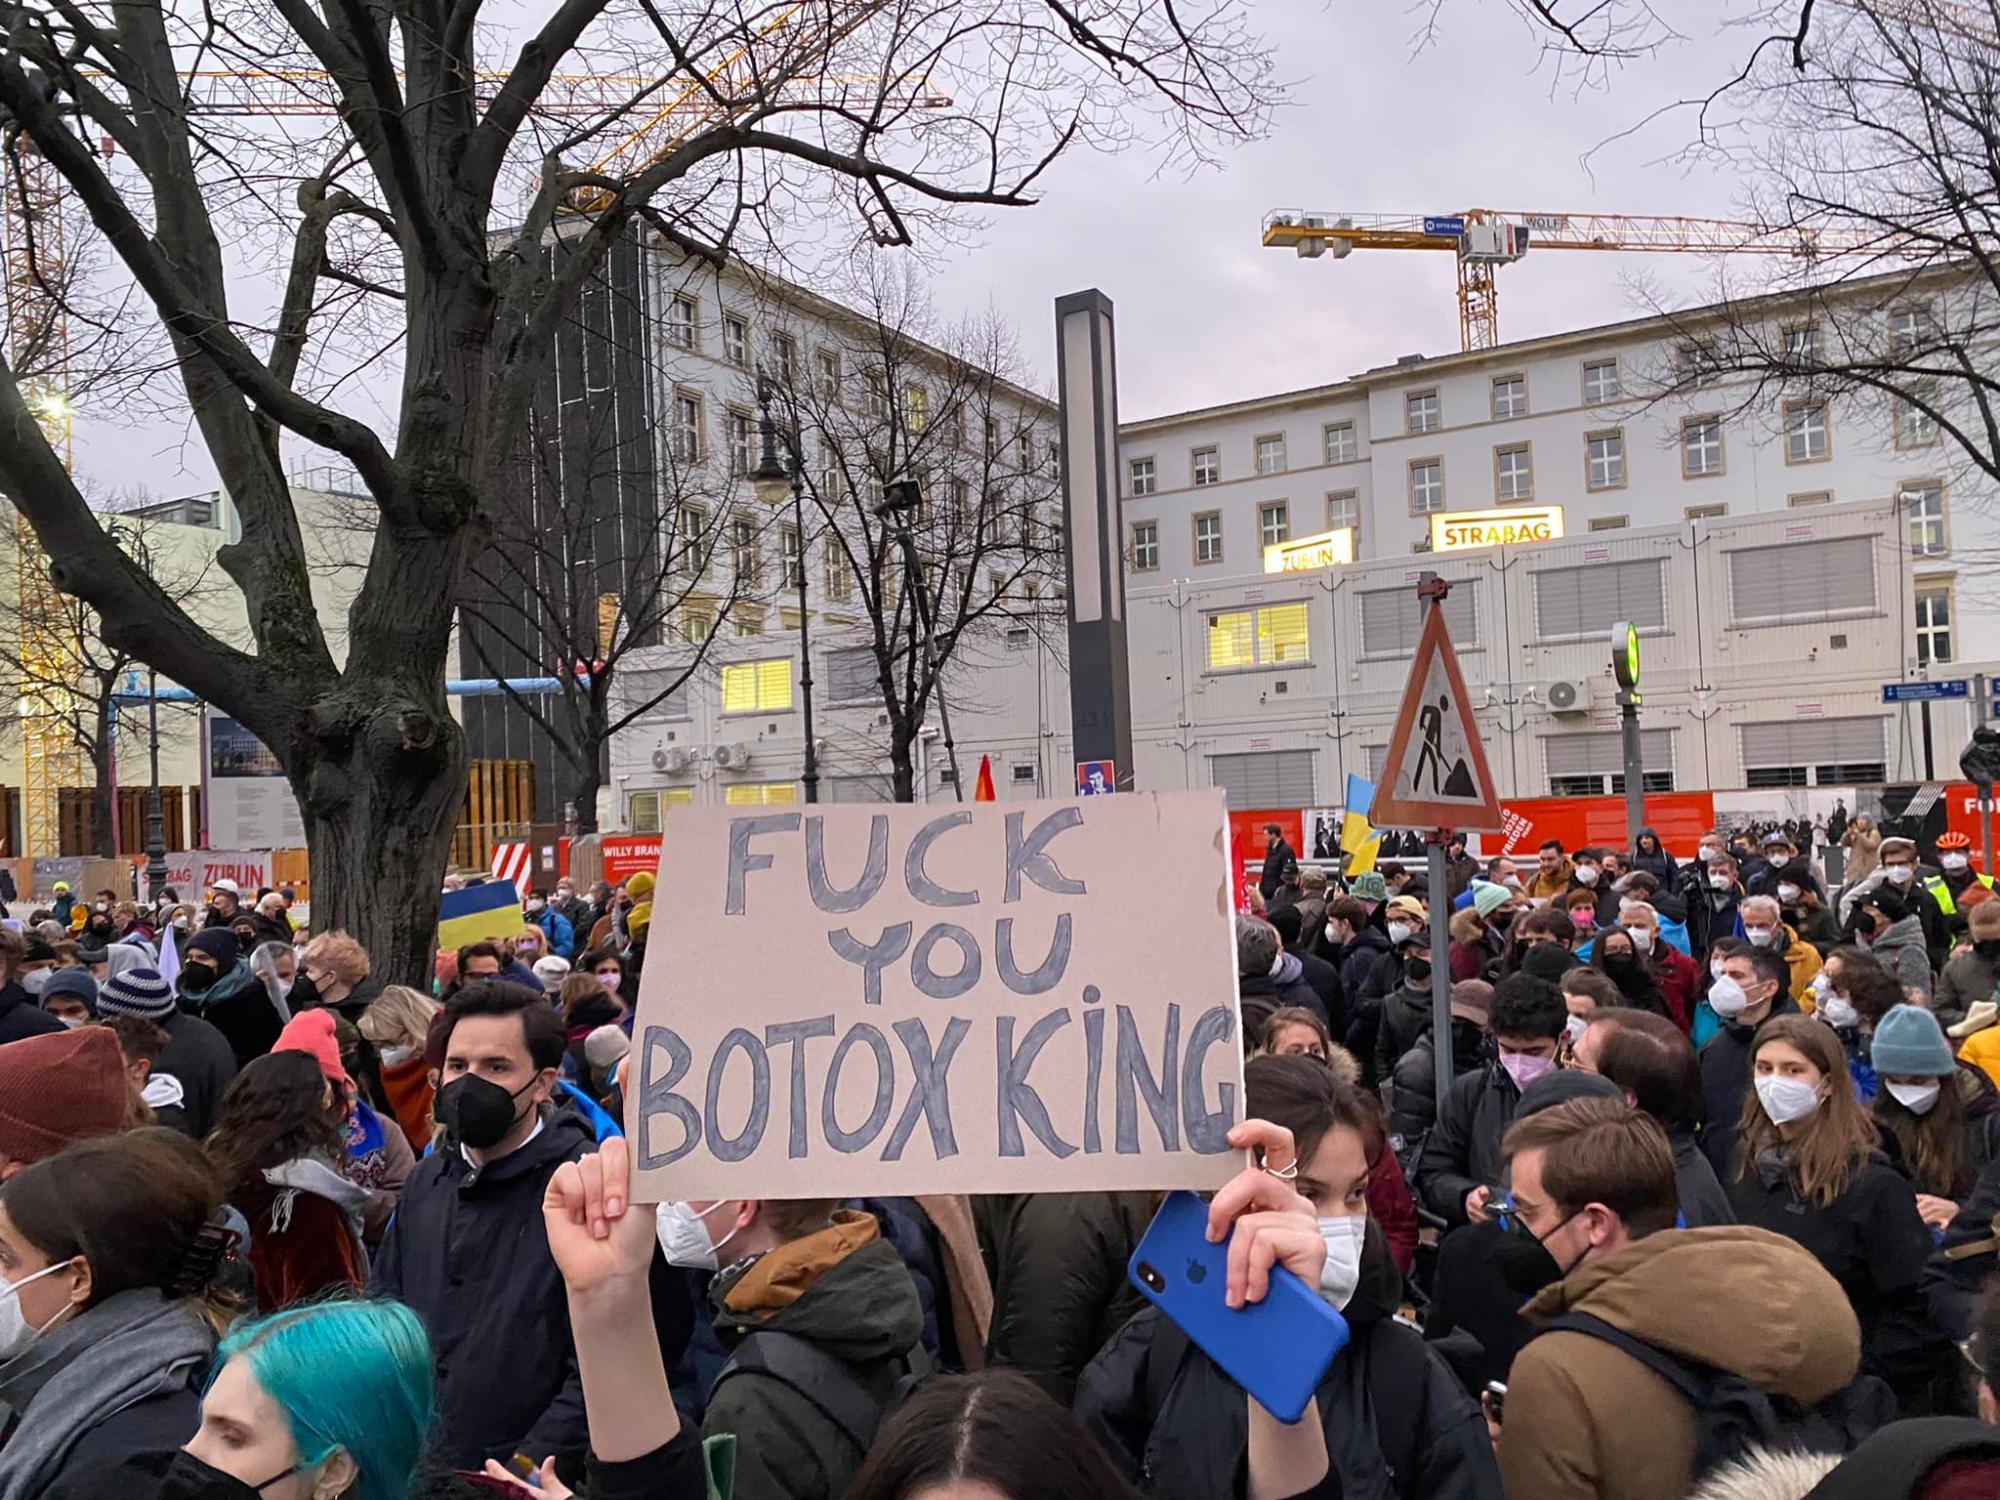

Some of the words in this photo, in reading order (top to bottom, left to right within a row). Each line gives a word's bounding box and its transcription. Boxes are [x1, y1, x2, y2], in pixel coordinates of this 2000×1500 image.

[1526, 217, 1568, 229] WOLFF
[1445, 522, 1551, 546] STRABAG
[1501, 817, 1528, 857] FRIEDEN
[1502, 813, 1519, 837] 2020
[602, 846, 633, 857] WILLY
[725, 806, 1086, 916] FUCK
[142, 868, 192, 885] SBAG
[828, 913, 1072, 1005] YOU
[637, 1015, 972, 1171] BOTOX
